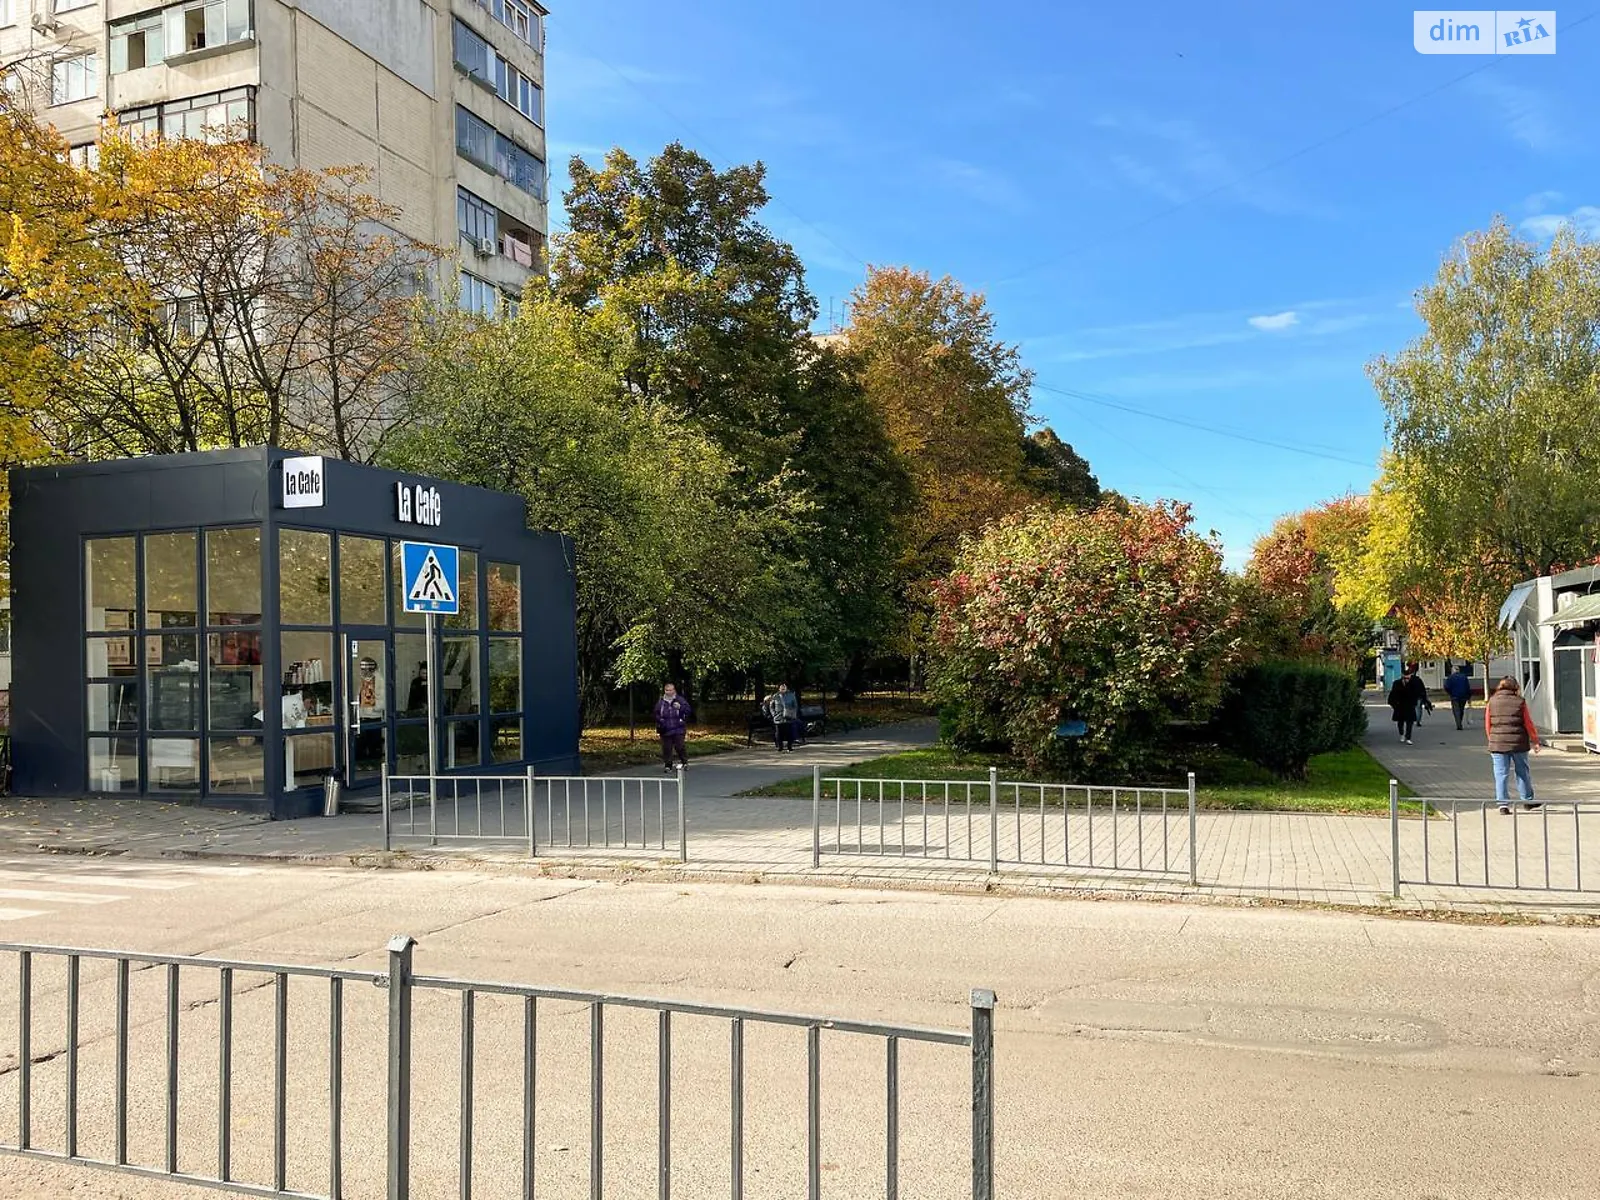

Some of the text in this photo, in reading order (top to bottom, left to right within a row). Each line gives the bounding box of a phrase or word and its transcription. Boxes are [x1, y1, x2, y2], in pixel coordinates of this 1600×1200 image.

[286, 469, 321, 496] La Cafe
[397, 480, 441, 527] La Cafe
